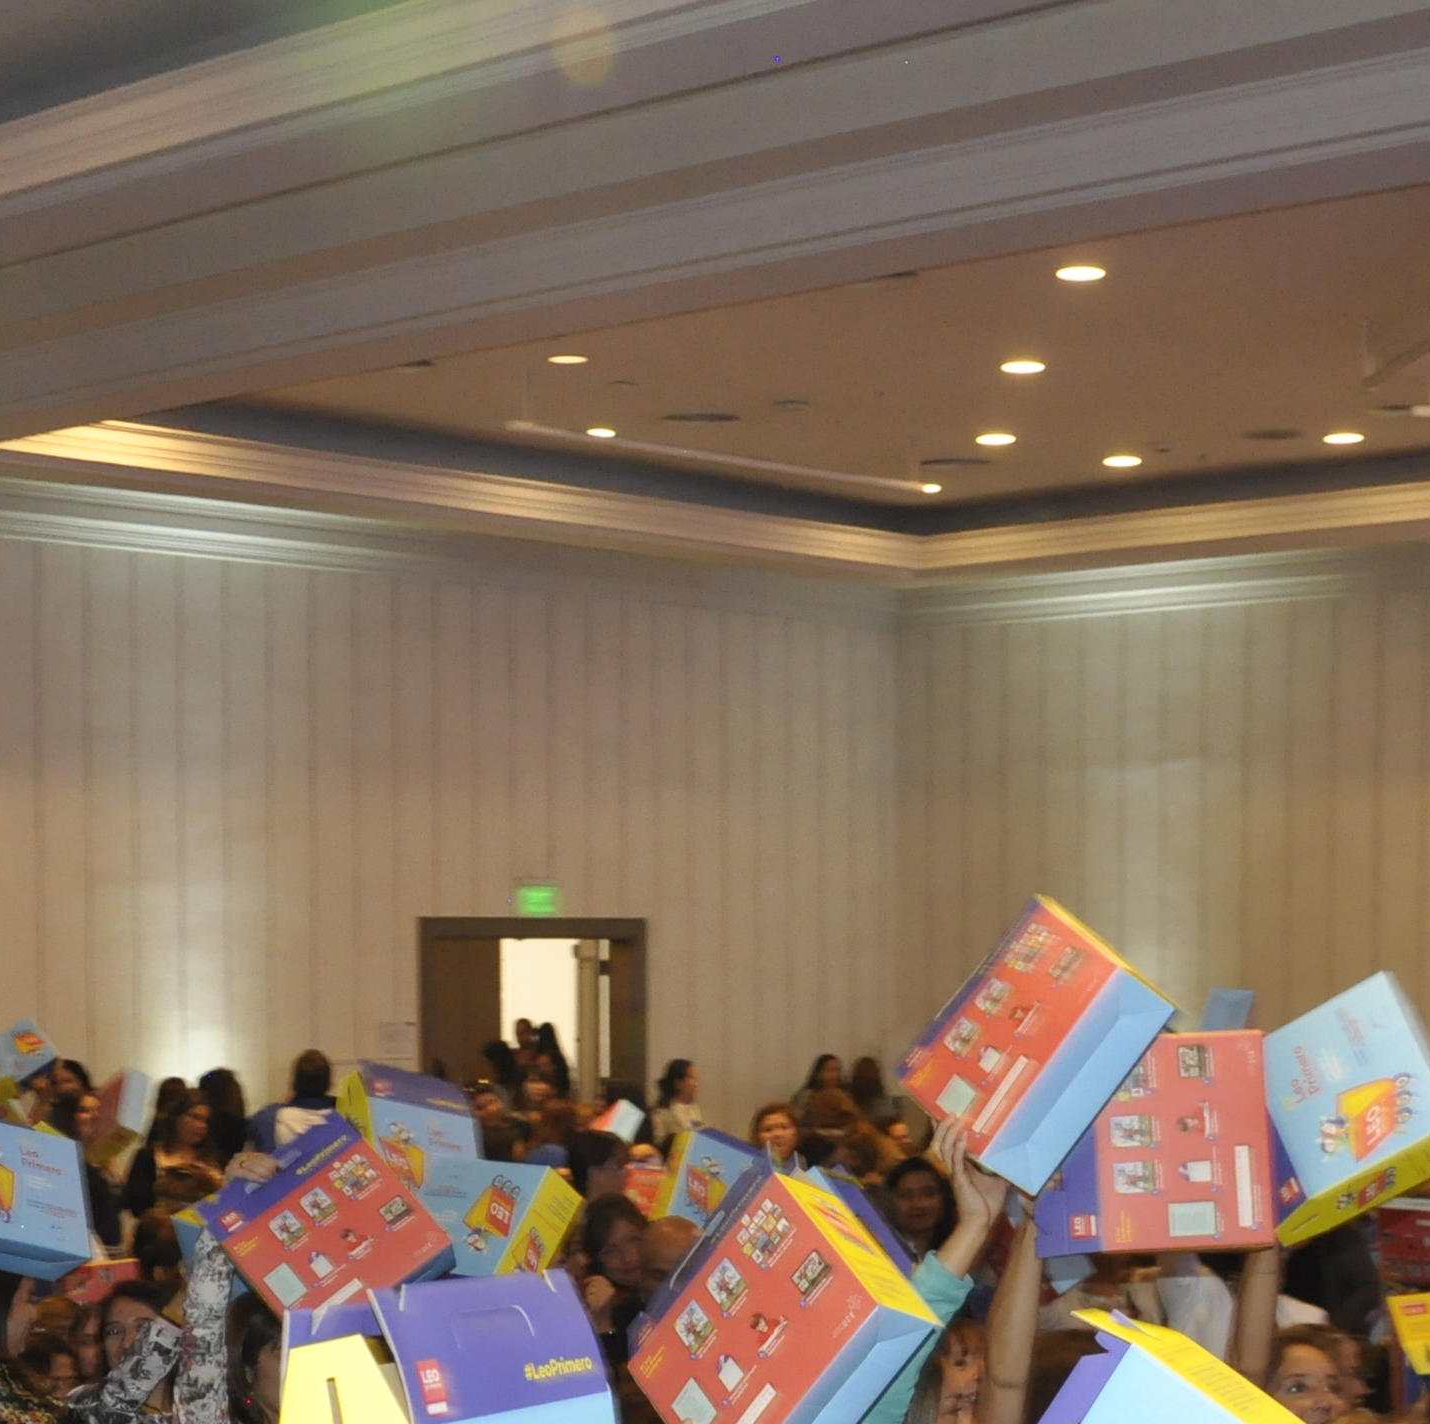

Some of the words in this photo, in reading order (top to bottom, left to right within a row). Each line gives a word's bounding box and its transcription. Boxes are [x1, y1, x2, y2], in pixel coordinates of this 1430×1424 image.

[1366, 1105, 1380, 1146] LEO
[687, 1176, 706, 1197] LEO
[420, 1369, 440, 1386] LEO
[524, 1356, 593, 1381] #LeoPrimero
